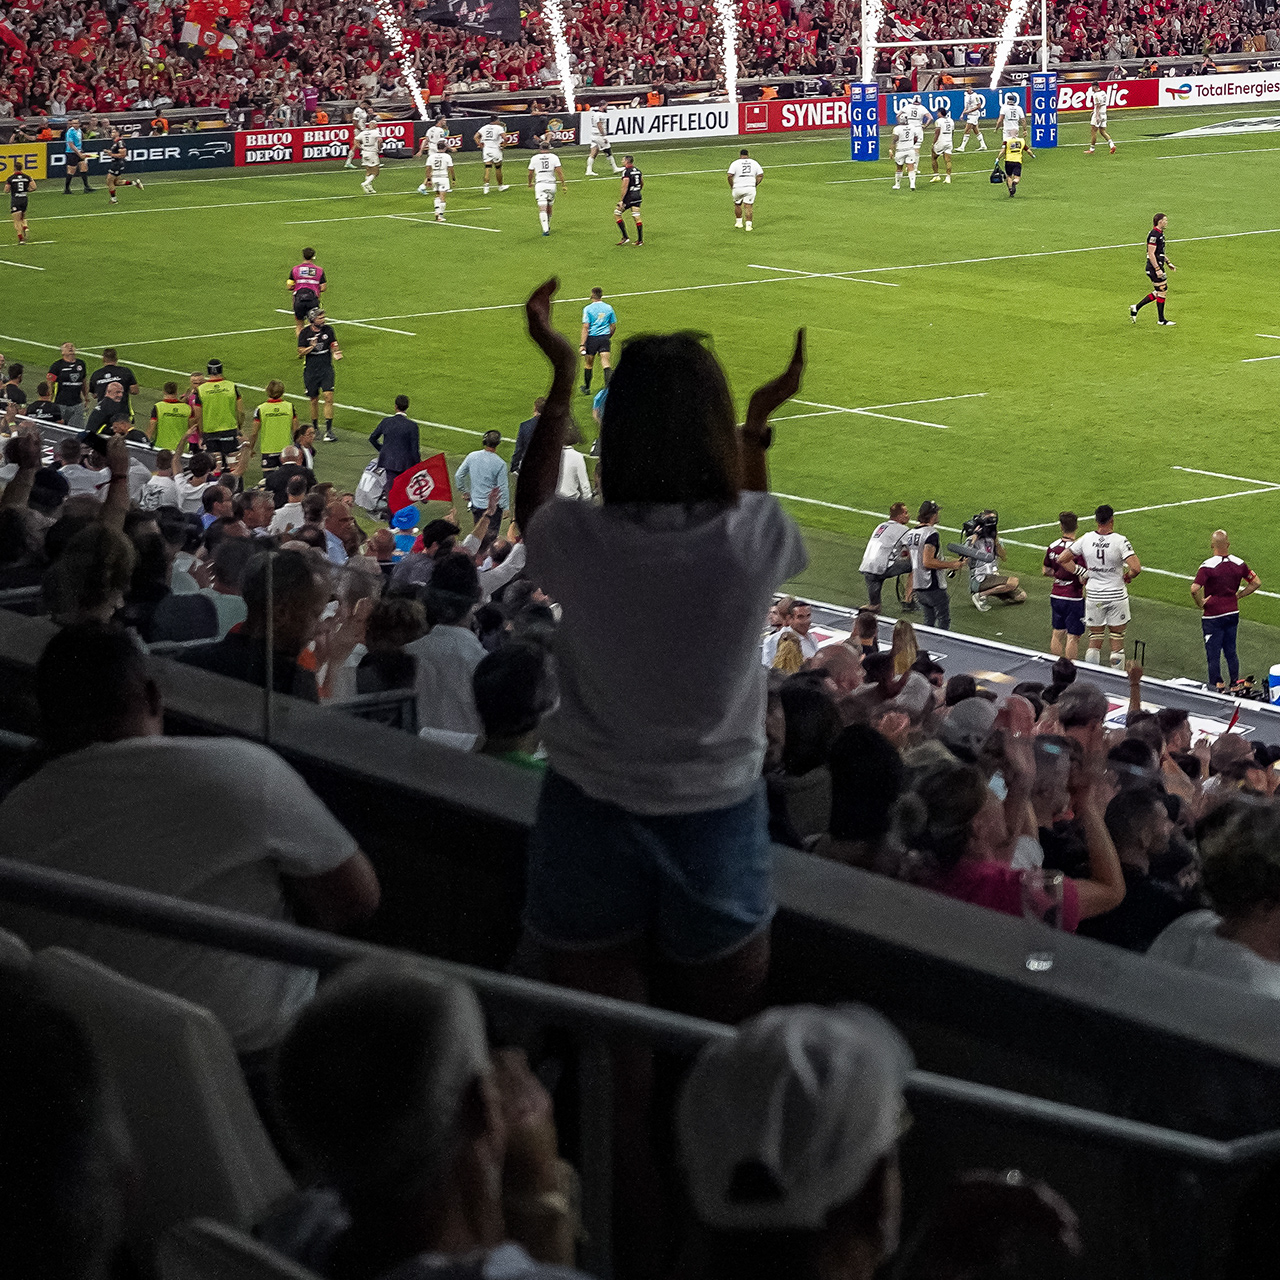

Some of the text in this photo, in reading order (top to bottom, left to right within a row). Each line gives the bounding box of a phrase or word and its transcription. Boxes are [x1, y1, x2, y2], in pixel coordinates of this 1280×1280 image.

[1057, 83, 1129, 110] Betlic
[1196, 81, 1280, 99] TotalEnergies
[606, 116, 645, 136] LAIN
[648, 110, 729, 134] AFFLELOU
[782, 101, 851, 128] SYNER
[246, 132, 292, 147] BRICO
[303, 128, 349, 143] BRICO
[246, 145, 293, 163] DEPÔT
[303, 141, 350, 159] DEPÔT
[1096, 549, 1105, 565] 4
